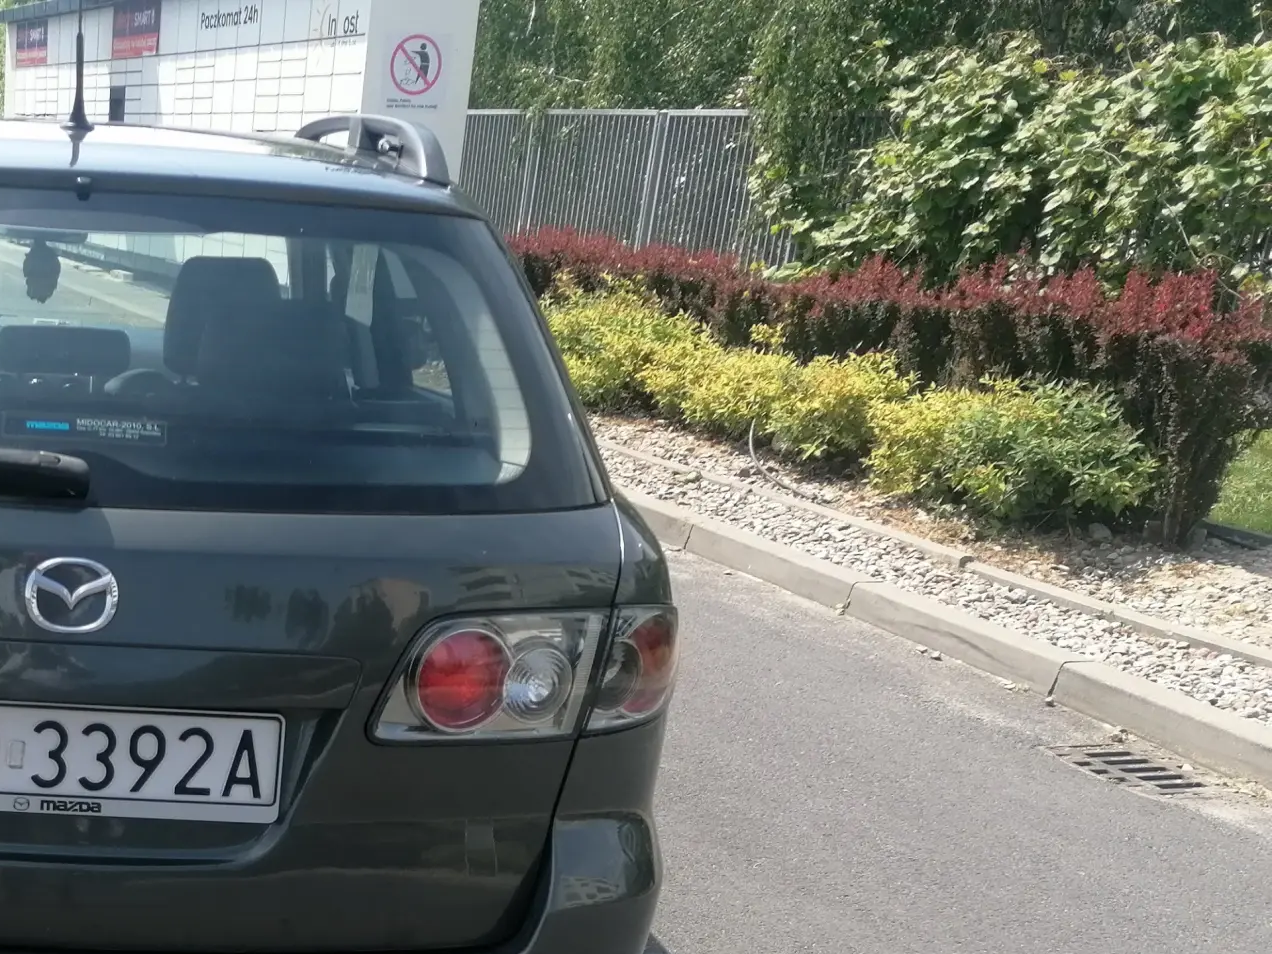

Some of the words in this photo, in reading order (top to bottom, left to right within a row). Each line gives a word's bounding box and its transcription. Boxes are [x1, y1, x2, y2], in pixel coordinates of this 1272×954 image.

[201, 8, 242, 30] Paczkomat
[243, 4, 259, 25] 24h
[29, 719, 262, 800] 3392A
